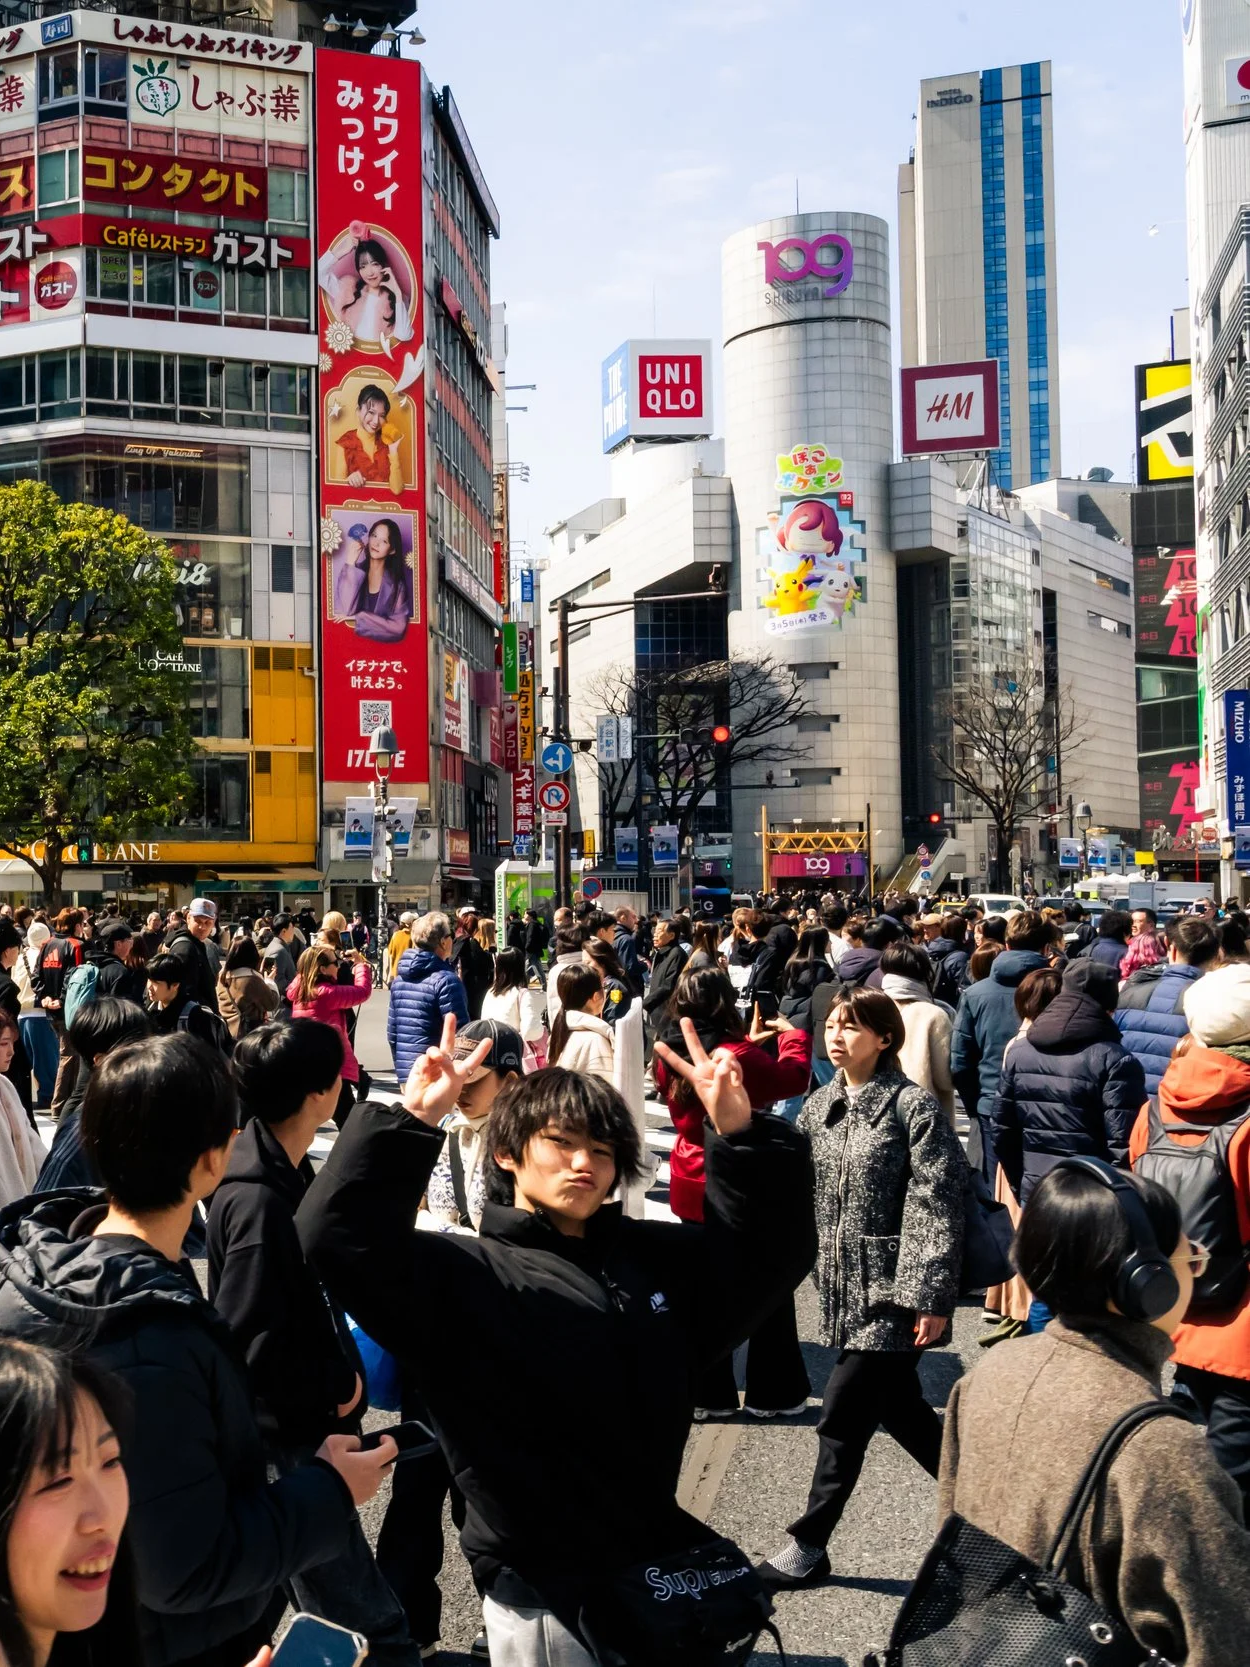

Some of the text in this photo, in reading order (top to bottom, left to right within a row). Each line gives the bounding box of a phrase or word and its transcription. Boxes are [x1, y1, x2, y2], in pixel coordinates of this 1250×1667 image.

[44, 19, 70, 40] 寿司
[113, 18, 303, 64] しゃぶしゃぶバイキング
[193, 75, 301, 122] しゃぶ葉
[927, 94, 973, 108] INDIGO
[336, 79, 364, 192] みっけ。
[373, 83, 400, 211] カワイイ
[85, 155, 260, 206] コンタクト
[101, 256, 126, 265] OPEN
[212, 231, 293, 269] ガスト
[757, 233, 854, 298] 109
[40, 282, 73, 298] ガスト
[646, 363, 690, 385] UNI
[646, 388, 696, 414] QLO
[927, 391, 974, 423] H&M
[780, 472, 841, 490] ポケモン
[808, 611, 827, 622] 発売
[345, 658, 408, 674] イチナナで、
[506, 646, 514, 668] レイク
[350, 675, 403, 690] 叶えよう。
[1234, 701, 1245, 743] MIZUHO
[506, 731, 516, 758] アコム
[347, 749, 406, 768] 17LE
[516, 768, 533, 832] スギ薬局
[1233, 775, 1245, 820] みずほ銀行
[804, 857, 830, 875] 109
[645, 1566, 750, 1601] Supreme
